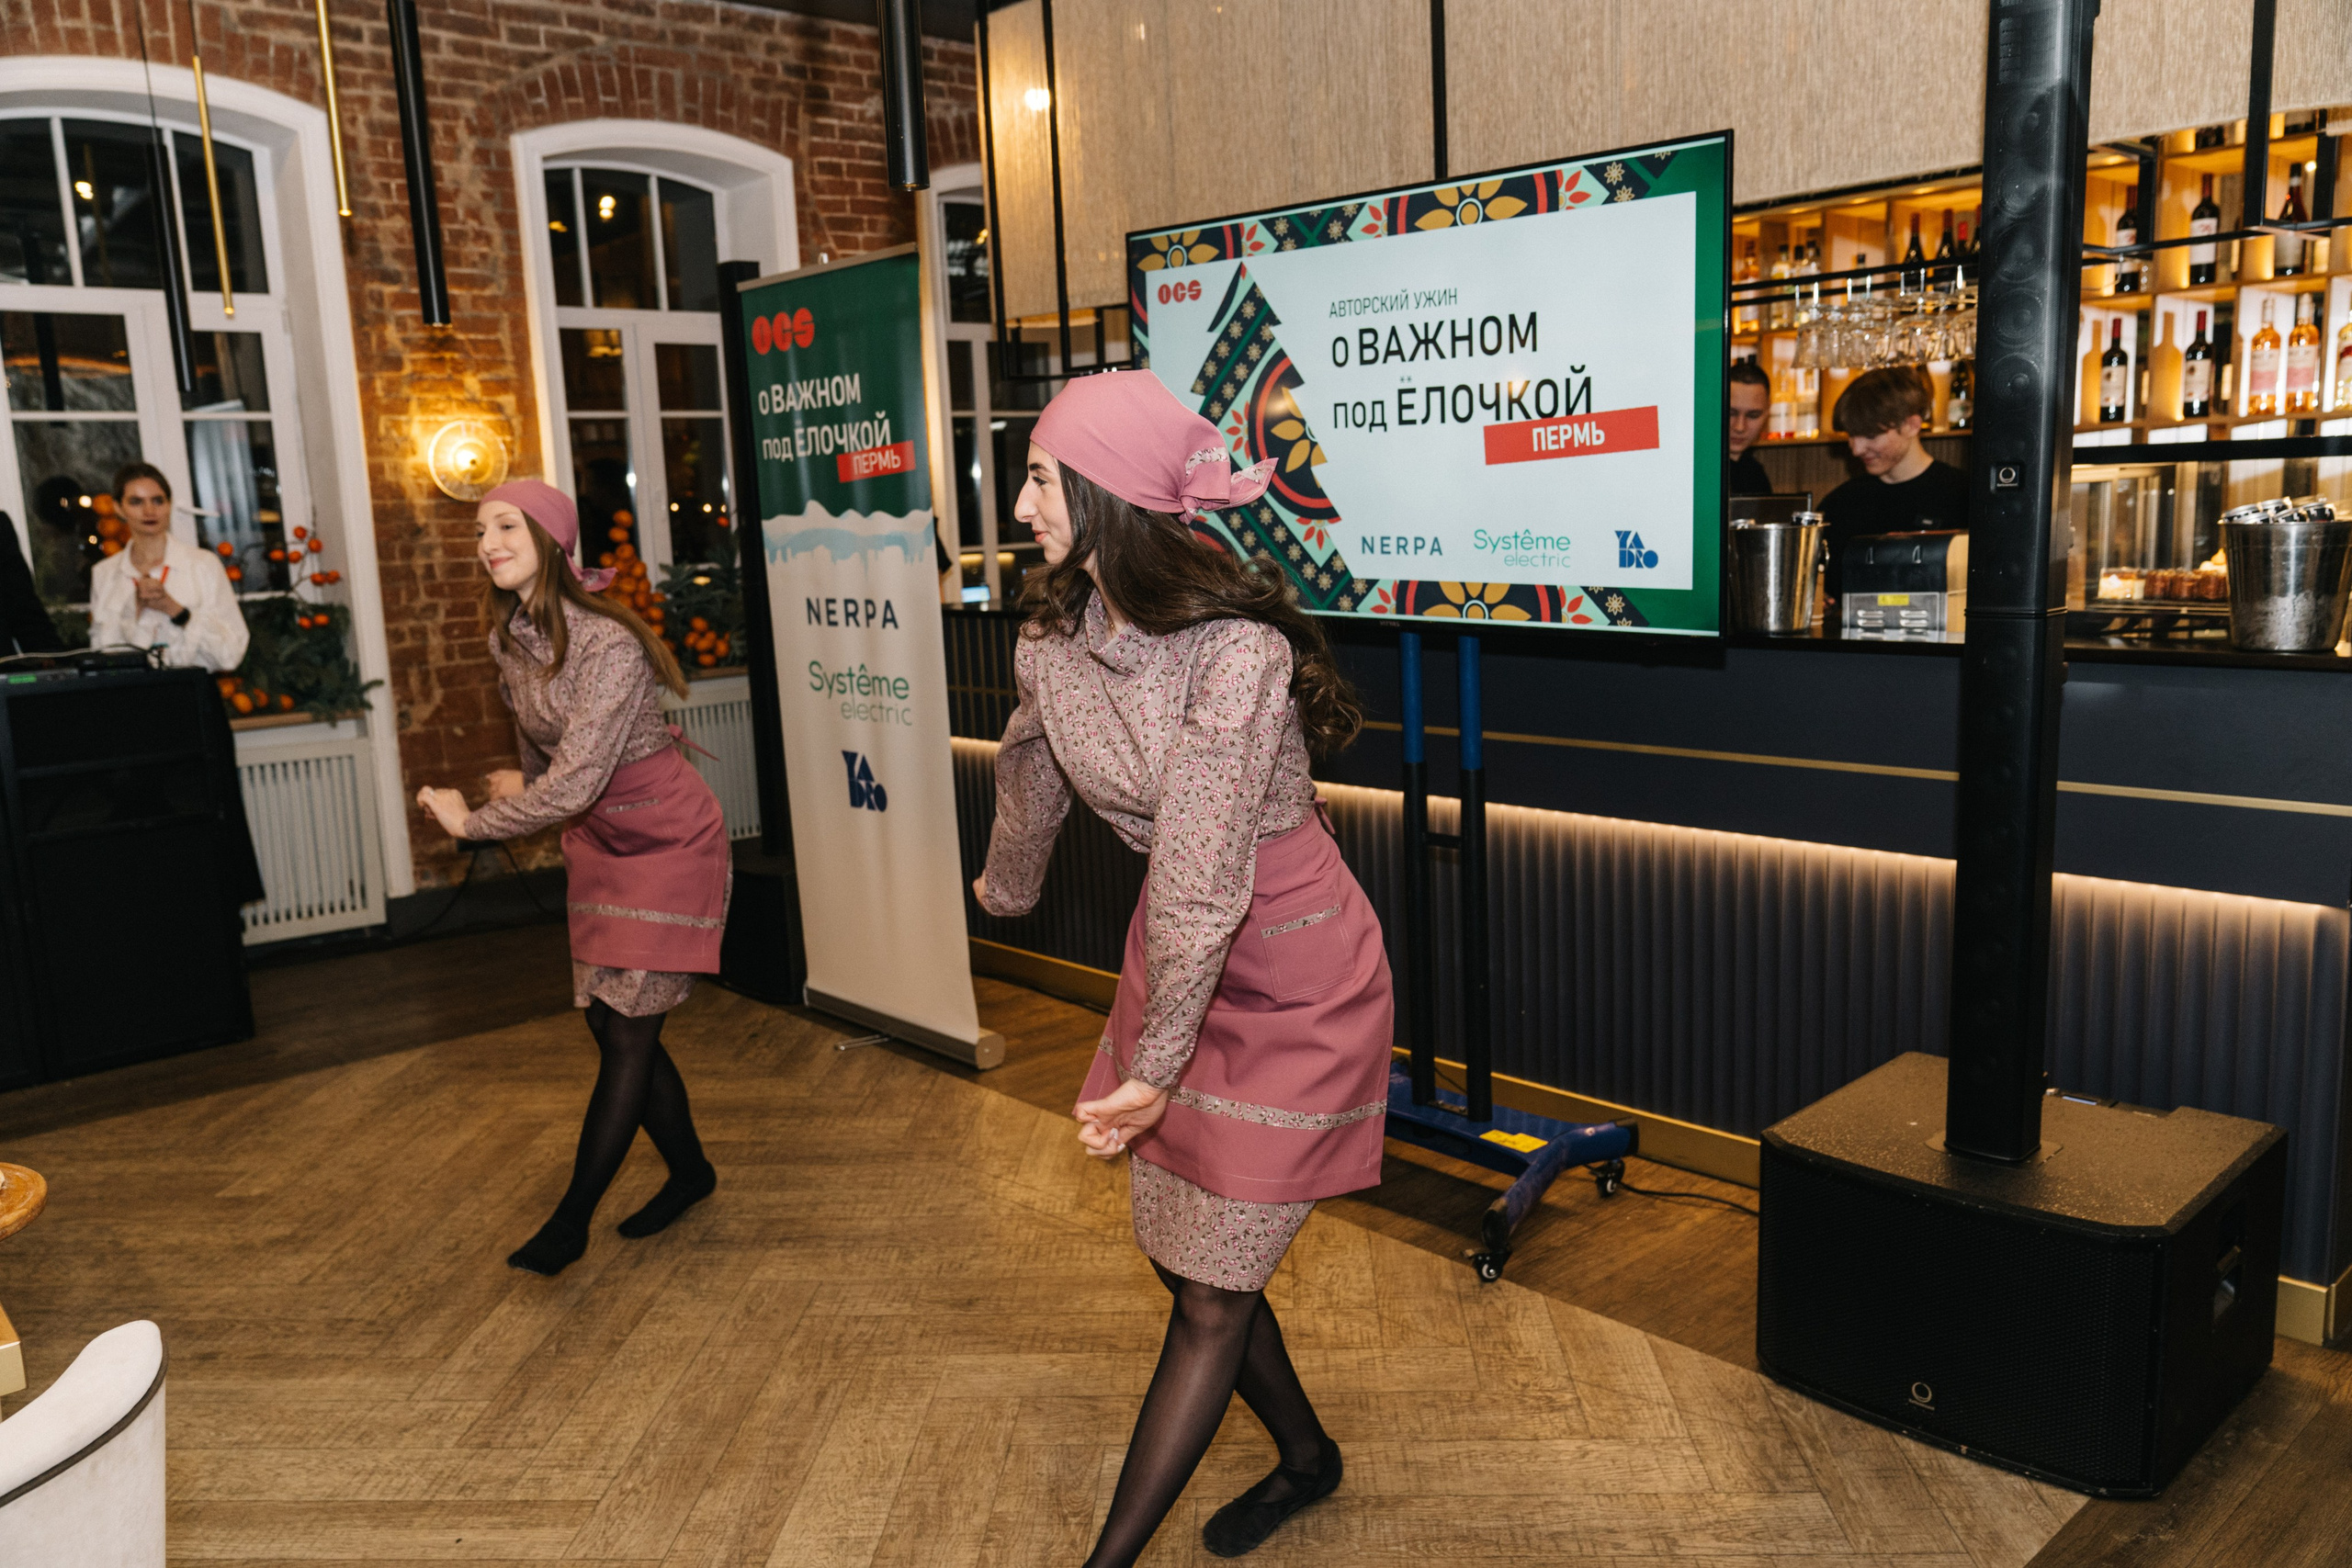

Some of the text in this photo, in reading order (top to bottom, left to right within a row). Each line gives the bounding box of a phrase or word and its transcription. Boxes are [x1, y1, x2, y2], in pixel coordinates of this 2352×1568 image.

[1158, 279, 1202, 305] OCS
[1329, 288, 1457, 319] АВТОРСКИЙ УЖИН
[752, 308, 815, 355] OCS
[1358, 311, 1538, 366] ВАЖНОМ
[771, 372, 862, 414] ВАЖНОМ
[1333, 364, 1592, 433] под ЁЛОЧКОЙ
[763, 436, 794, 463] под
[1532, 421, 1606, 452] ПЕРМЬ
[853, 448, 901, 476] ПЕРМЬ
[1362, 536, 1443, 557] NERPA
[1473, 529, 1571, 554] Systême
[1503, 551, 1571, 568] electric
[807, 597, 899, 629] NERPA
[808, 660, 910, 700] Systême
[840, 694, 913, 727] electric
